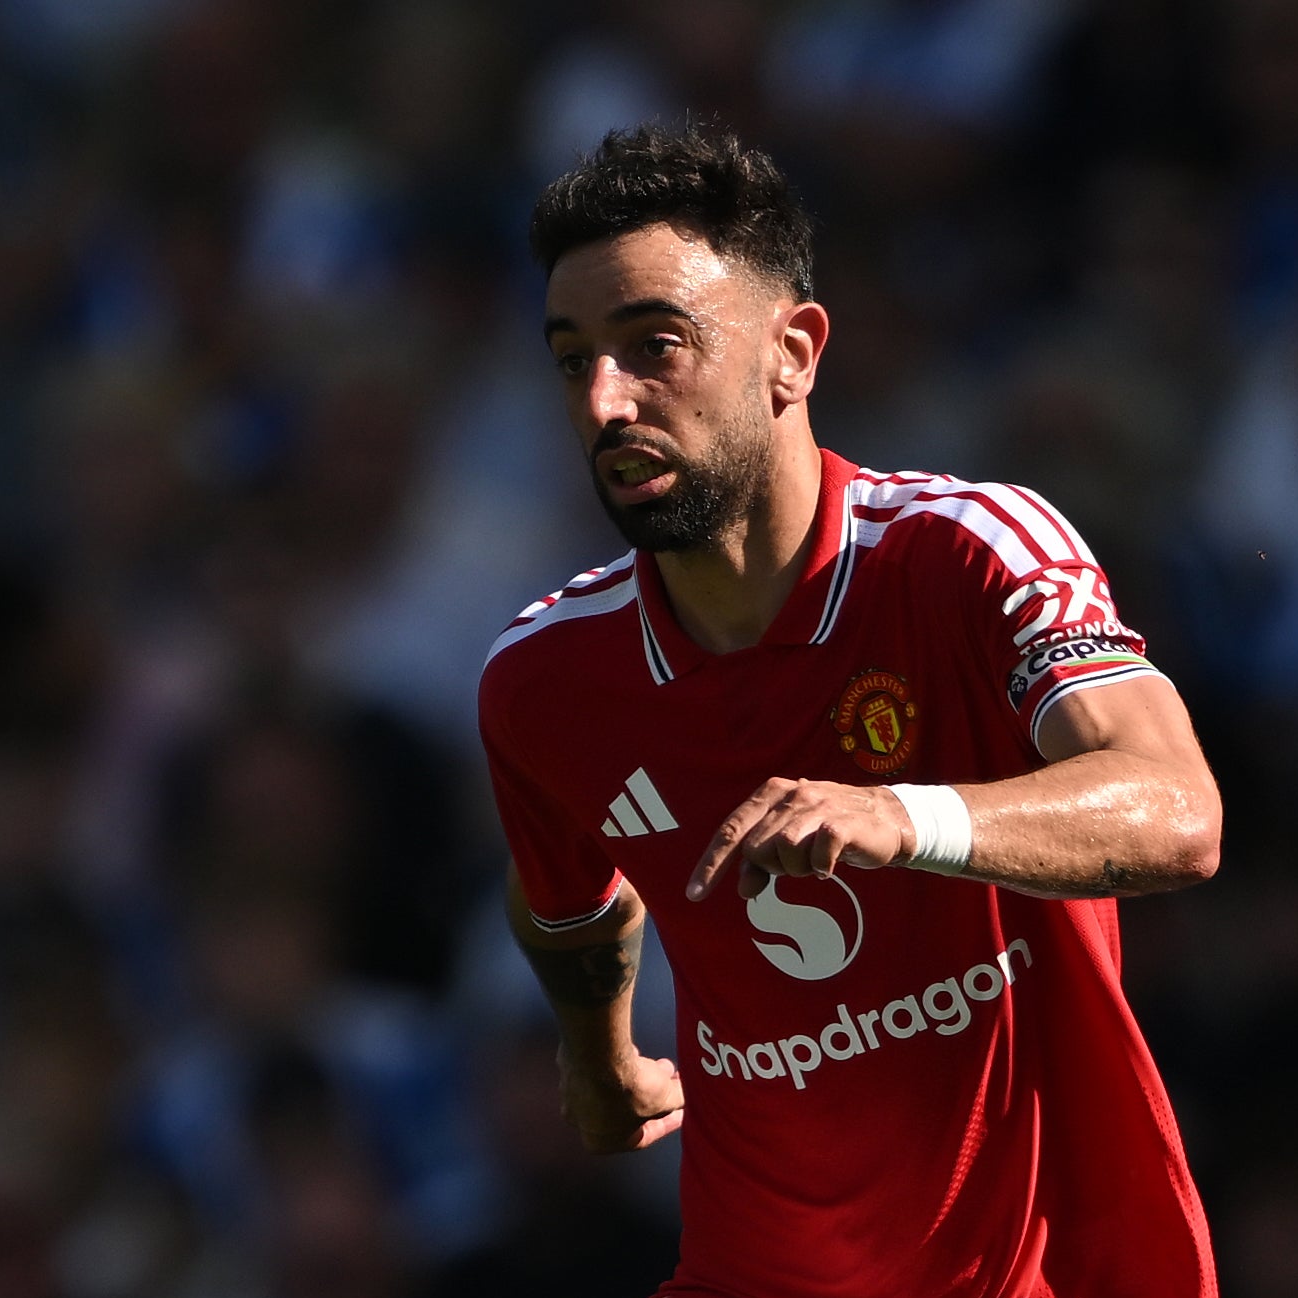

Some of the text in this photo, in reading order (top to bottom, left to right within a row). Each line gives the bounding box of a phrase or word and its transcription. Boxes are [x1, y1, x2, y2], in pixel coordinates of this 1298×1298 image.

[1019, 618, 1143, 656] TECHNOL
[840, 675, 905, 723] MANCHESTER
[871, 740, 910, 770] UNITED
[697, 938, 1033, 1090] Snapdragon
